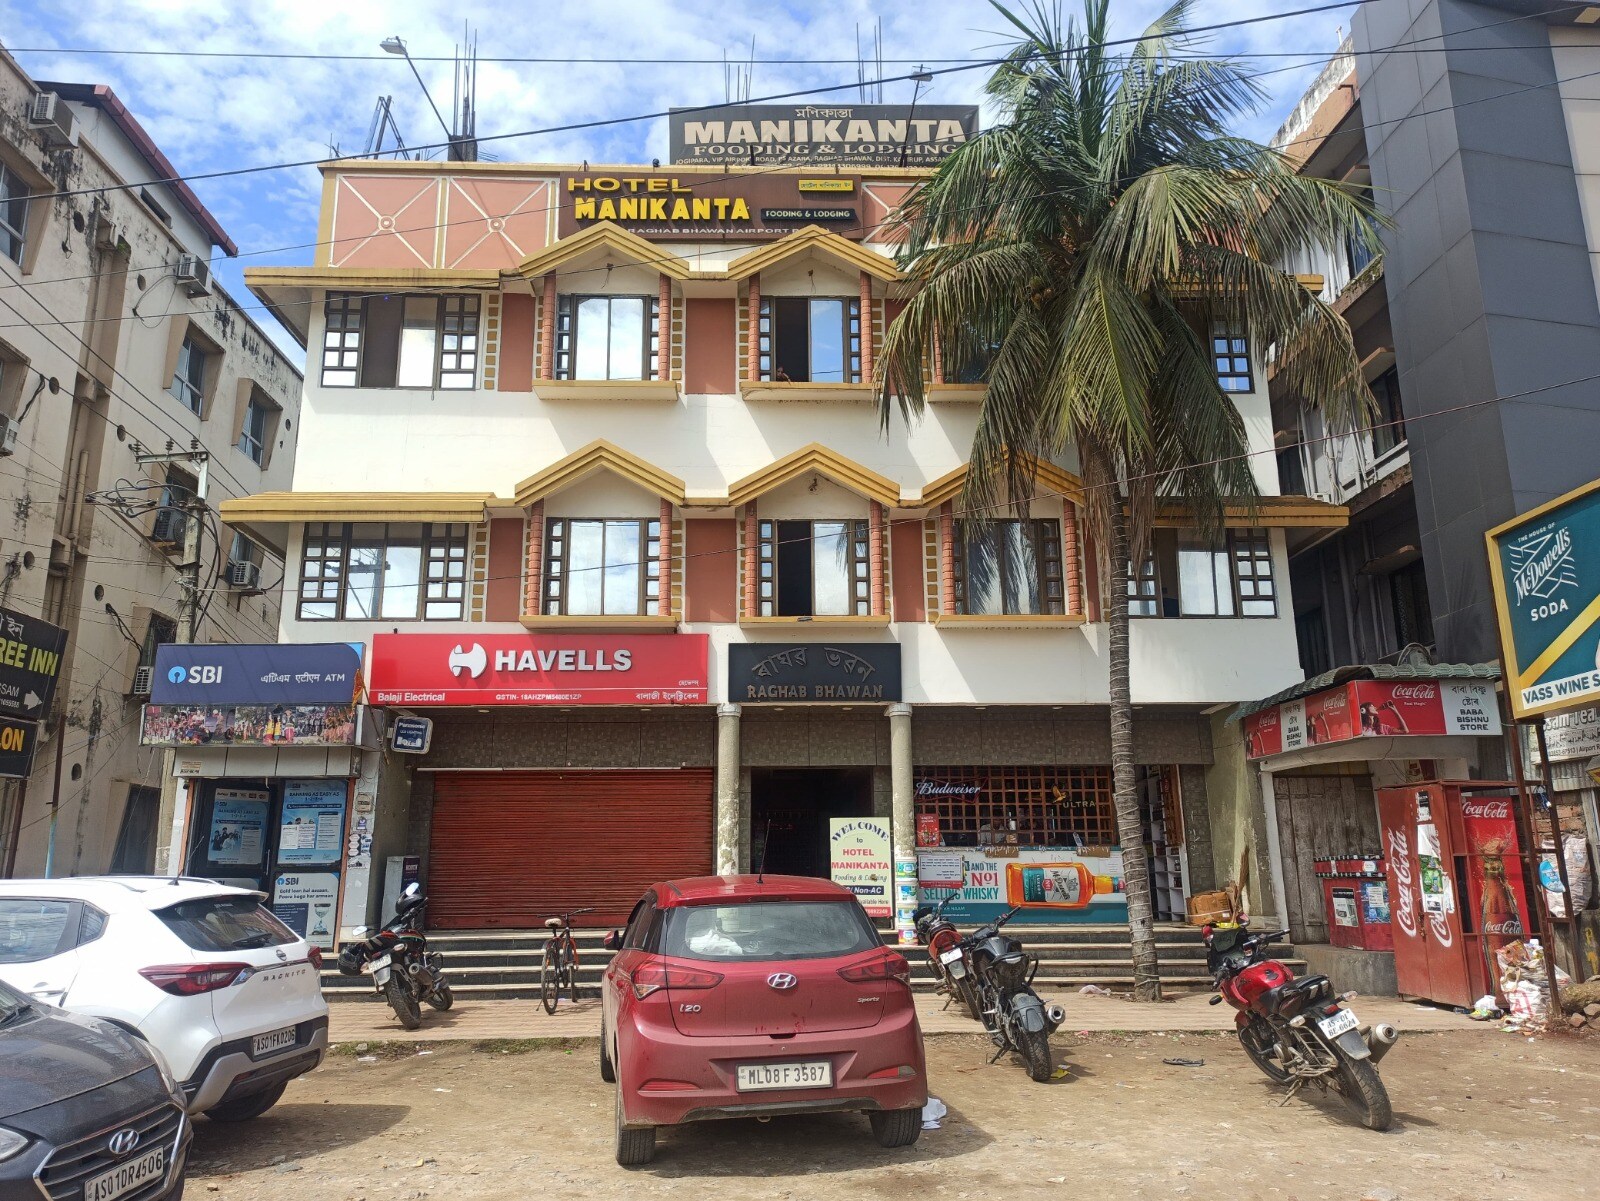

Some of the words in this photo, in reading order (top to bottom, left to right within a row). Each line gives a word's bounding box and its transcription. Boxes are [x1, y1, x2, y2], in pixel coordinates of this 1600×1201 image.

[684, 120, 966, 144] MANIKANTA
[694, 144, 809, 156] FOODING
[818, 144, 836, 154] &
[568, 178, 692, 192] HOTEL
[575, 197, 750, 220] MANIKANTA
[766, 210, 802, 218] FOODING
[814, 210, 850, 218] LODGING
[1518, 534, 1528, 543] THE
[1528, 528, 1546, 540] HOUSE
[1514, 527, 1571, 606] McDowell's
[1530, 598, 1568, 622] SODA
[28, 646, 59, 677] INN
[494, 649, 632, 672] HAVELLS
[188, 666, 222, 684] SBI
[295, 672, 320, 684] एटीएम
[324, 674, 346, 682] ATM
[0, 682, 20, 698] SAM
[378, 692, 402, 702] Balaji
[404, 692, 446, 702] Electrical
[496, 693, 520, 701] GSTIN-
[747, 684, 807, 698] RAGHAB
[815, 684, 883, 698] BHAWAN
[1392, 684, 1436, 699] Coca-Cola
[1523, 686, 1553, 704] VASS
[1555, 678, 1590, 696] WINE
[917, 782, 981, 795] Budweiser
[1062, 801, 1096, 809] ULTRA
[1462, 802, 1508, 818] Coca-Cola
[842, 848, 874, 856] HOTEL
[832, 862, 890, 870] MANIKANTA
[971, 862, 984, 871] AND
[986, 862, 998, 871] THE
[1388, 825, 1416, 937] Coca-Cola
[963, 888, 999, 900] WHISKY
[1484, 920, 1522, 935] Coca-Cola
[680, 1004, 702, 1013] i20
[256, 1028, 296, 1052] AS01FK0206
[748, 1068, 780, 1085] ML08
[784, 1069, 790, 1083] F
[794, 1066, 825, 1082] 3587
[94, 1152, 162, 1201] AS01DR4506
